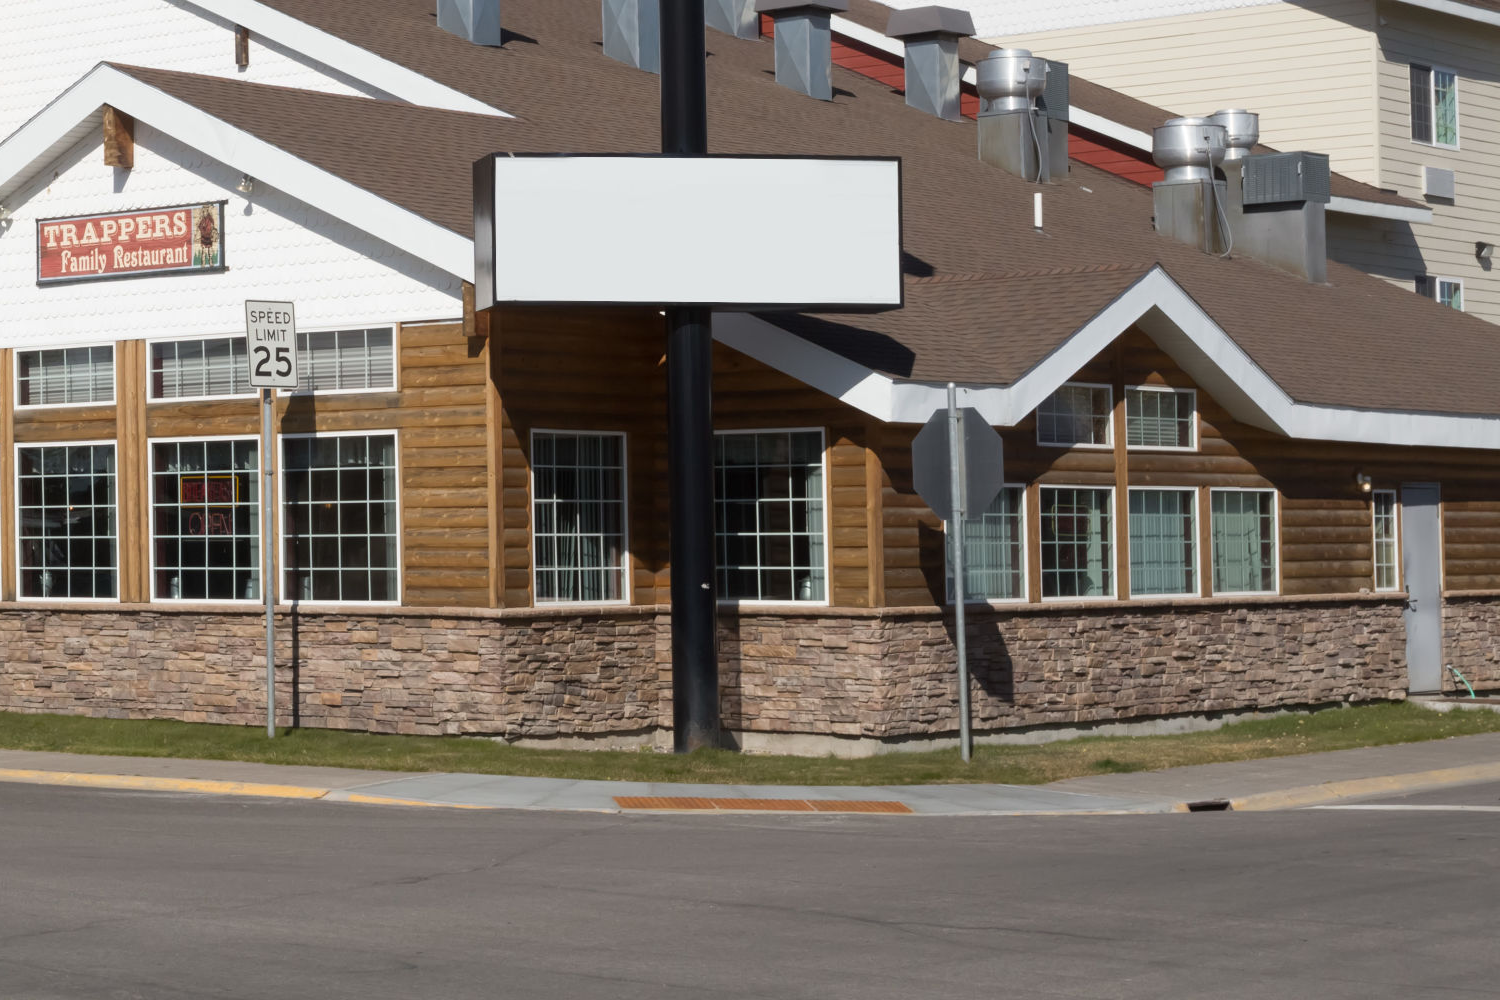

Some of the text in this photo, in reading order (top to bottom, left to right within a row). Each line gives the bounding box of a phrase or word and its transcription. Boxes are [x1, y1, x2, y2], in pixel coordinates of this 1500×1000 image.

[43, 211, 188, 250] TRAPPERS
[60, 242, 189, 274] Family Restaurant
[250, 310, 291, 325] SPEED
[255, 328, 287, 342] LIMIT
[253, 345, 293, 378] 25
